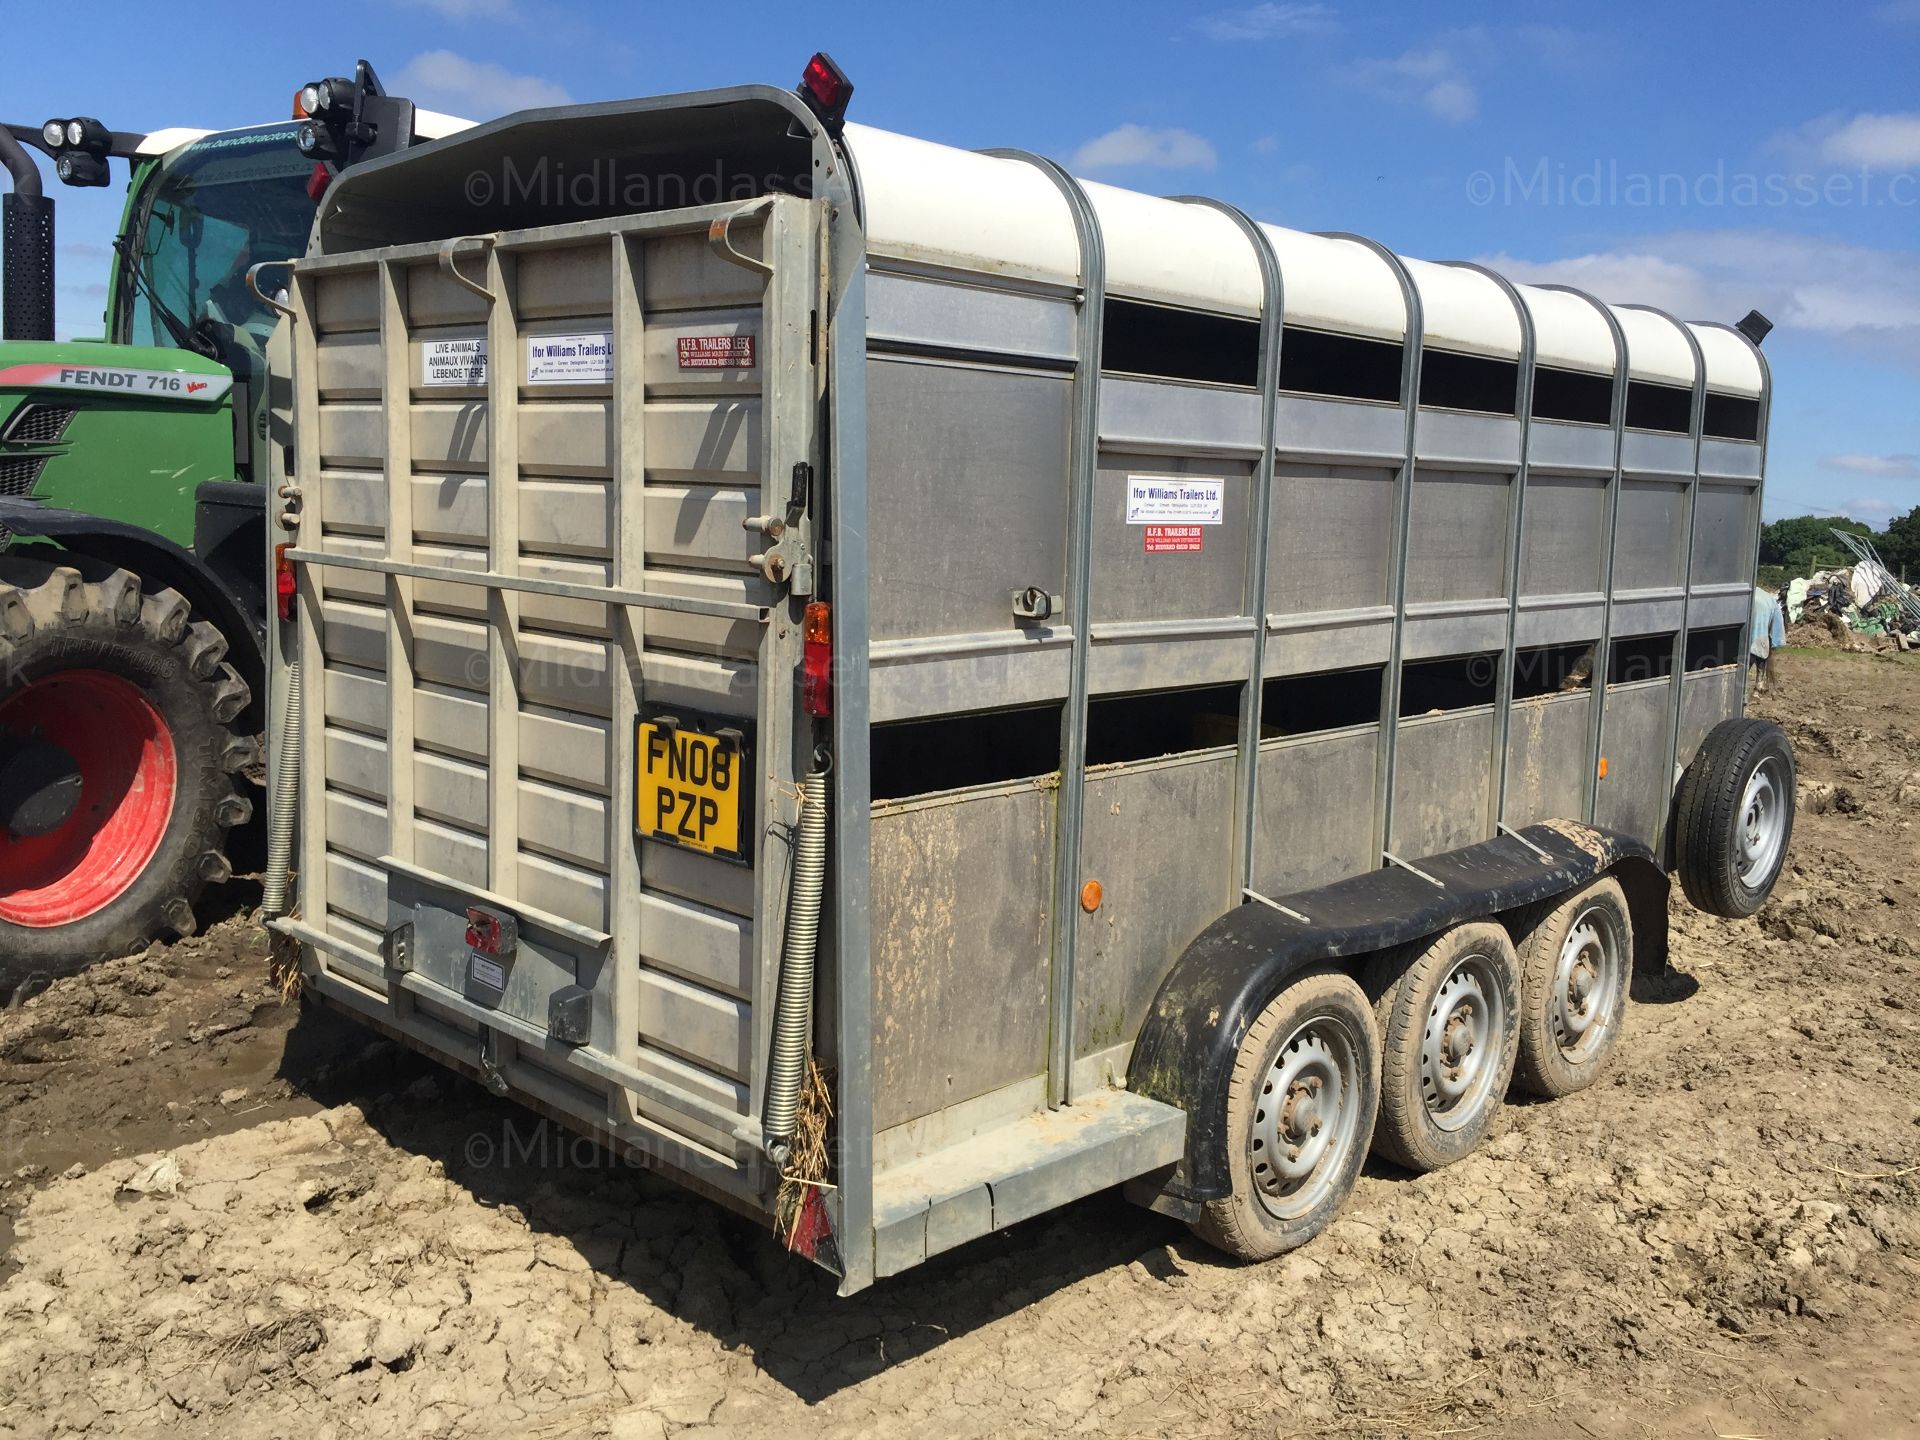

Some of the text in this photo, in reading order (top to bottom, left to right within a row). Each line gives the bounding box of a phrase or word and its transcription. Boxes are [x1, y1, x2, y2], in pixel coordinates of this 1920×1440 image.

[435, 342, 481, 353] LIVE ANIMALS
[532, 345, 544, 358] Ifor
[546, 345, 576, 358] Williams
[578, 343, 606, 357] Trailers
[699, 338, 731, 351] TRAILERS
[733, 337, 750, 350] LEEK
[429, 355, 488, 366] ANIMAUX VIVANTS
[60, 369, 137, 388] FENDT
[147, 376, 180, 391] 716
[433, 367, 484, 379] LEBENDE TIERE
[1133, 487, 1218, 501] Ifor Williams Trailers Ltd.
[1165, 528, 1188, 537] TRAILERS
[1189, 528, 1201, 537] LEEK
[647, 729, 731, 792] FN08
[657, 785, 718, 842] PZP
